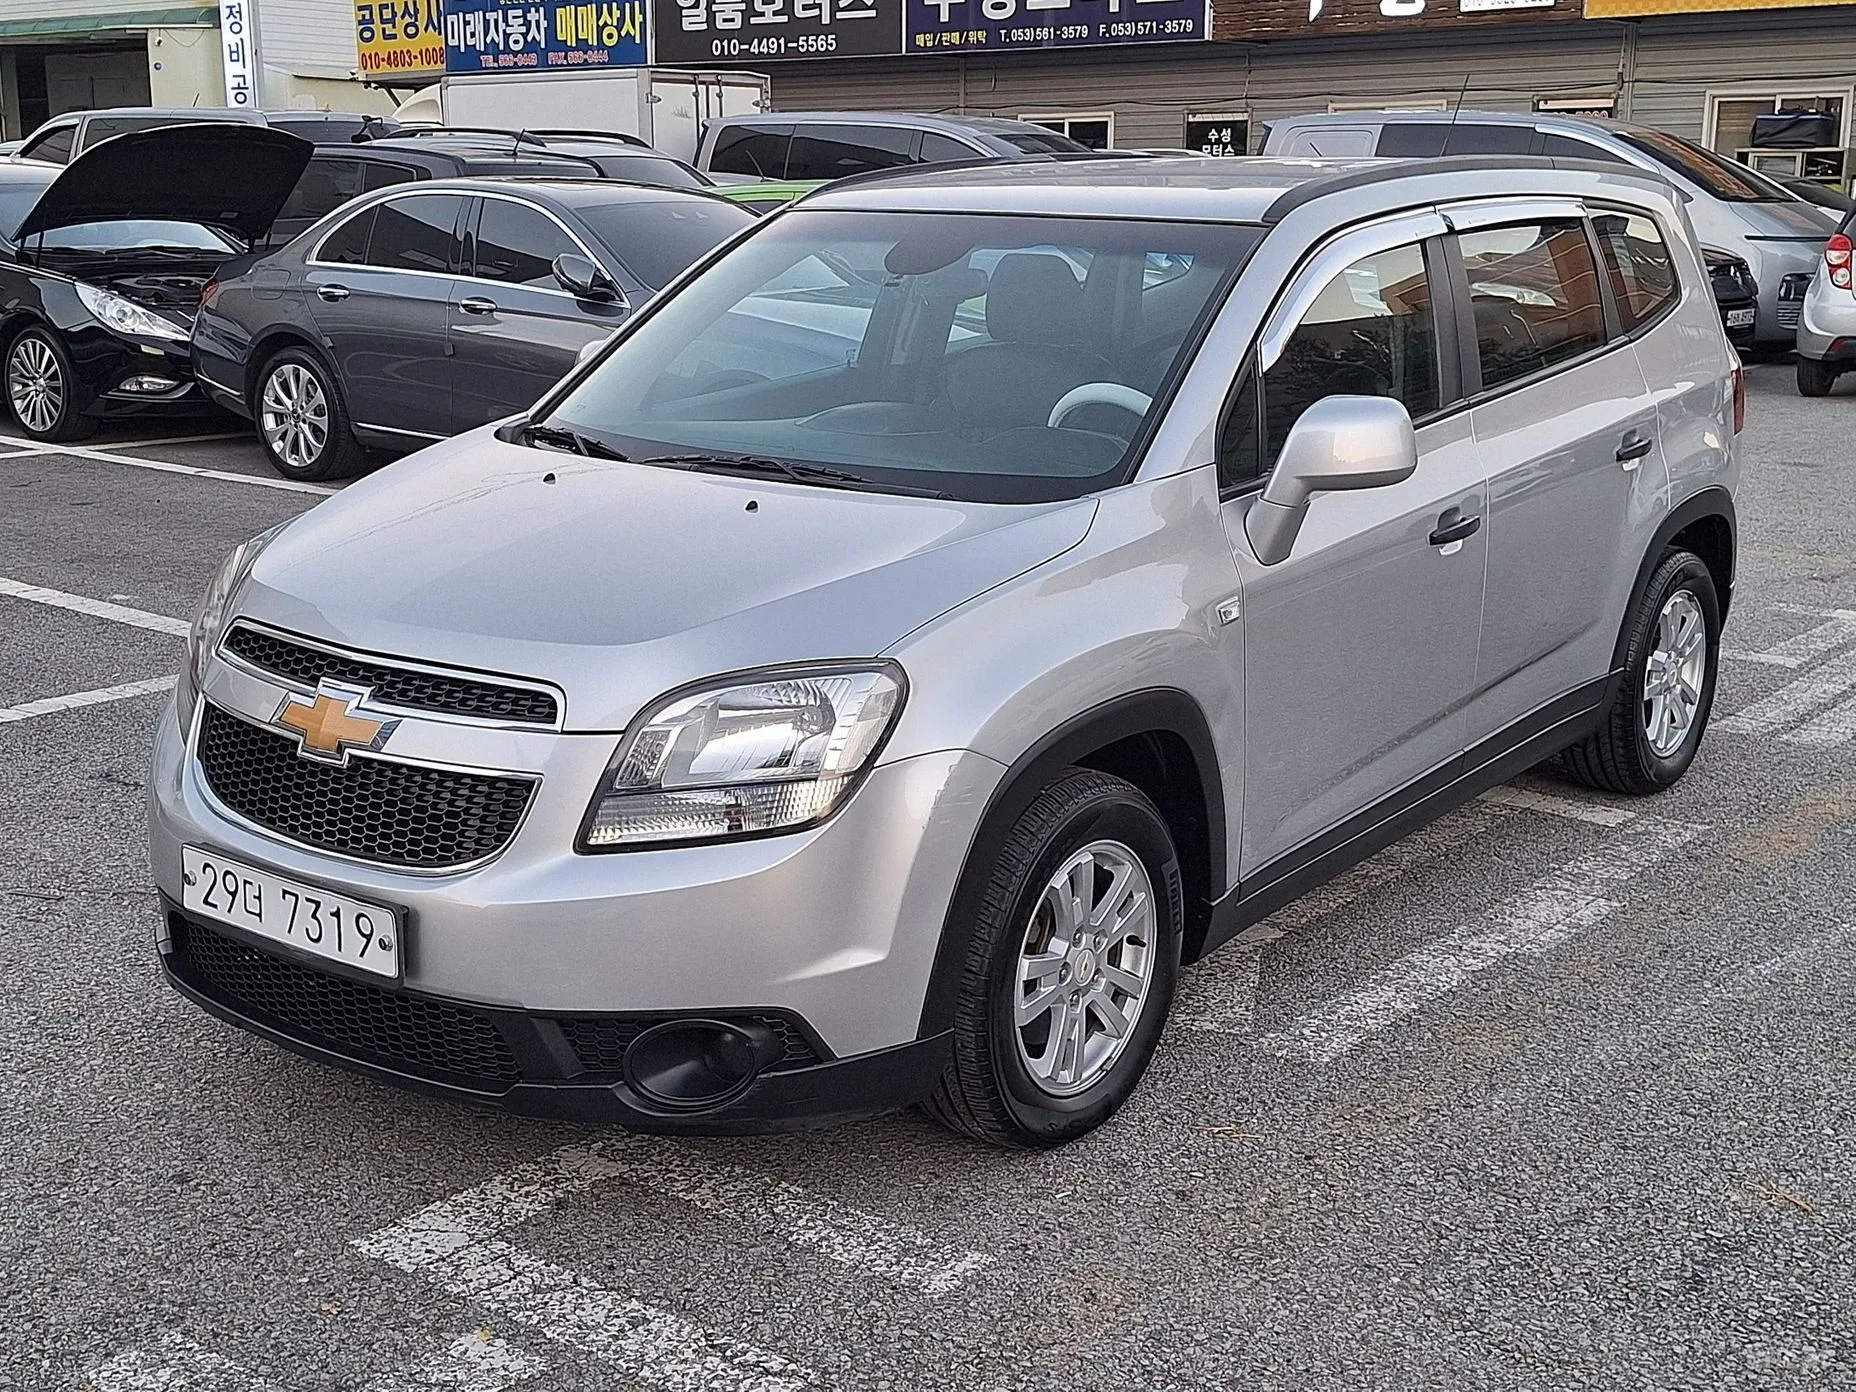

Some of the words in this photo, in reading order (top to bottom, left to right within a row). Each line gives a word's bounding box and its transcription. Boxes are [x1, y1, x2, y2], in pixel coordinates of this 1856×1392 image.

[357, 0, 443, 43] 공단상사
[447, 6, 547, 52] 미래자동차
[556, 0, 643, 47] 매매상사
[711, 34, 837, 56] 010-4491-5565
[361, 46, 445, 70] 010-4803-1008
[1207, 127, 1232, 143] 수성
[1201, 143, 1236, 157] 모터스
[202, 862, 263, 923] 29더
[281, 887, 375, 959] 7319
